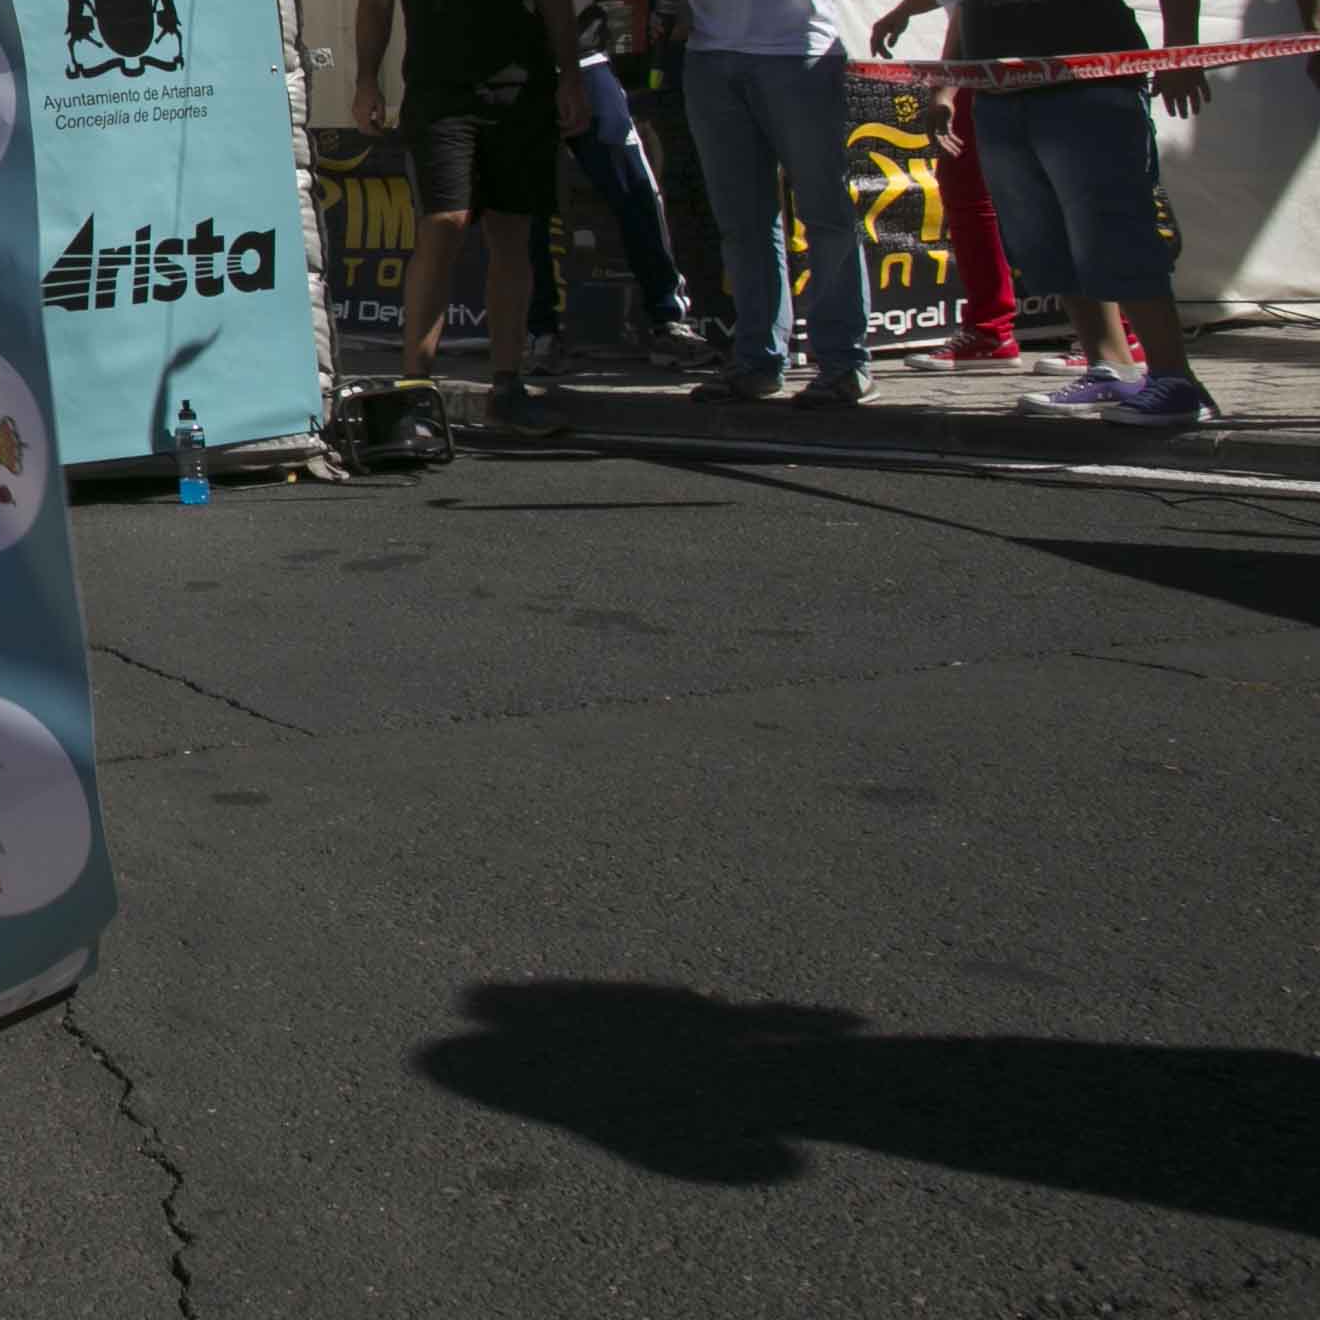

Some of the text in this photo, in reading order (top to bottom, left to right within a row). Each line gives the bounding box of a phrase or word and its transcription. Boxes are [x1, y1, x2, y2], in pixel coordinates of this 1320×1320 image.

[44, 83, 215, 113] Ayuntamiento de Artenara
[56, 104, 208, 130] Concejalía de Deportes
[41, 213, 276, 311] Arista
